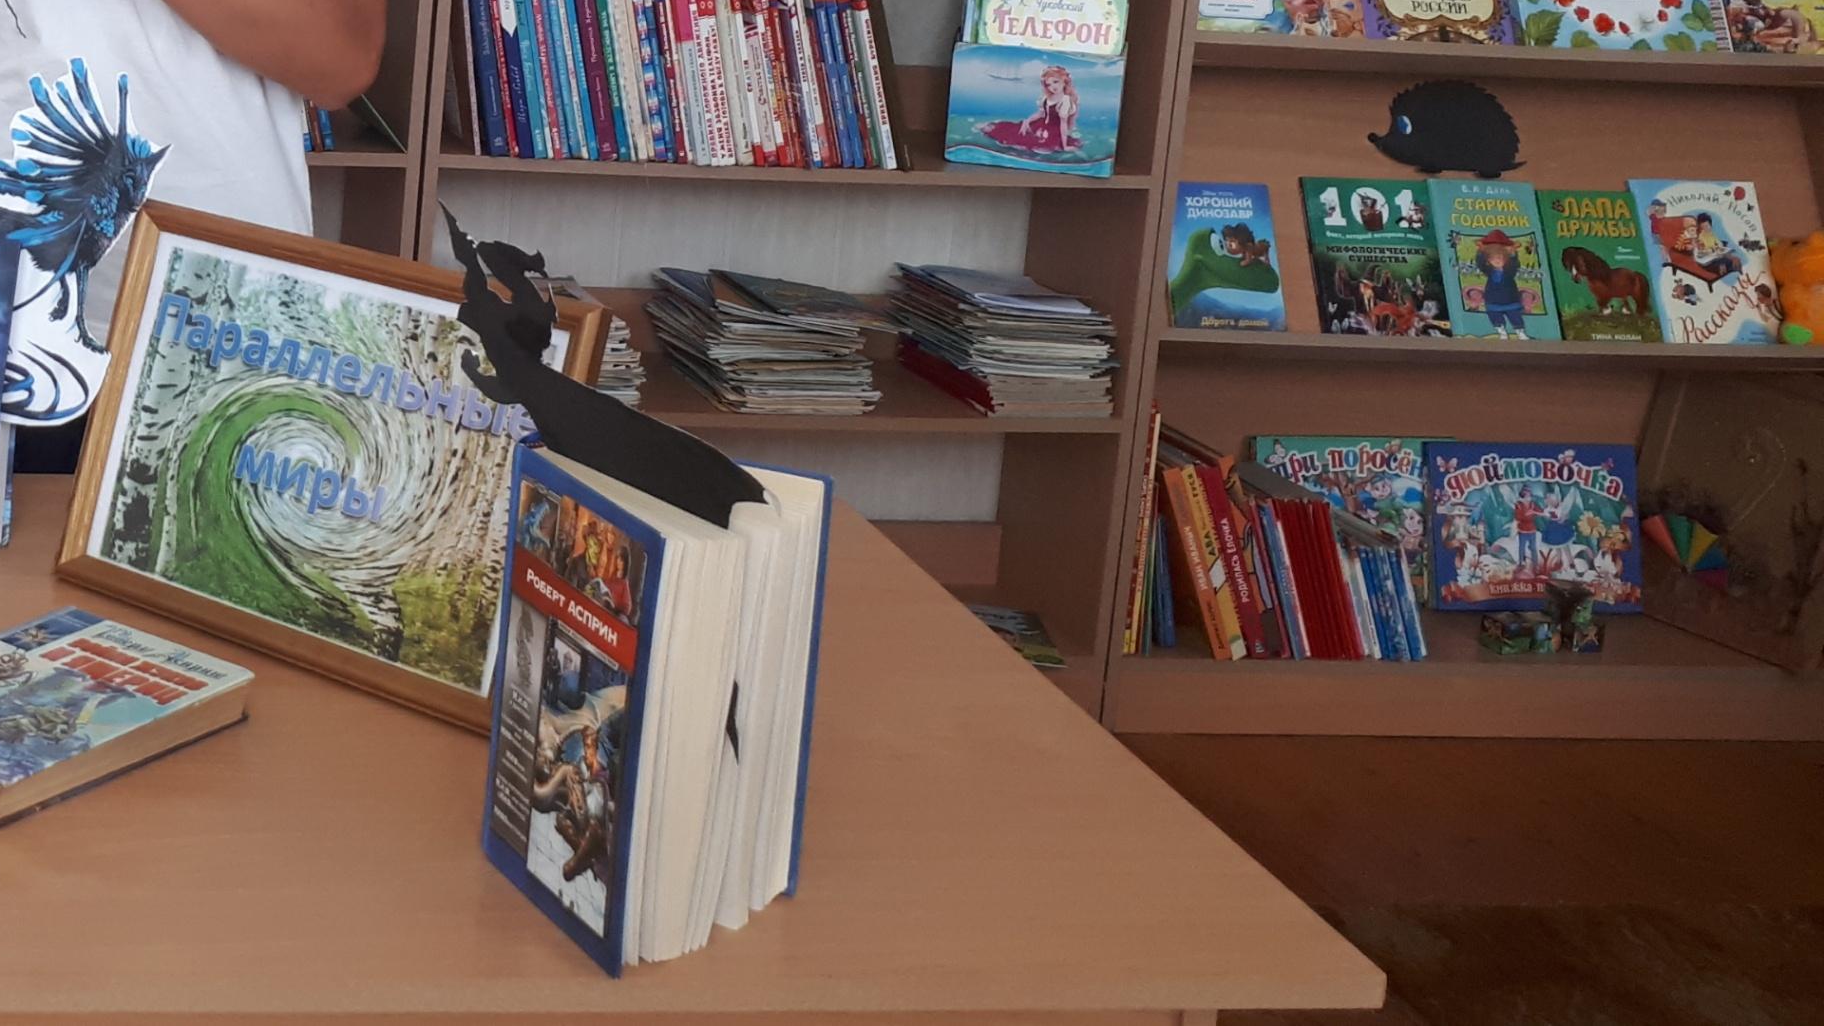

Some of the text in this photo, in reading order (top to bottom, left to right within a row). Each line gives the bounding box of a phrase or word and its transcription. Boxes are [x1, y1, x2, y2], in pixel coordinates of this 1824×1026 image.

[1411, 0, 1468, 15] РОССИИ
[992, 6, 1113, 46] ТЕЛЕФОН
[865, 18, 888, 126] ПРИКЛЮЧЕНИЯ БУРАТИНО
[1185, 195, 1253, 210] ХОРОШИЙ
[1186, 208, 1254, 220] ДИНОЗАВР
[1454, 197, 1520, 212] СТАРИК
[1561, 196, 1631, 220] ЛАПА
[1667, 194, 1722, 208] Николай
[1450, 213, 1530, 228] ГОДОВИК
[1727, 199, 1758, 232] Носов
[1556, 219, 1637, 239] ДРУЖБЫ
[1326, 244, 1427, 257] МИФОЛОГИЧЕСКИЕ
[1348, 254, 1409, 265] СУЩЕСТВА
[1680, 270, 1766, 344] Рассказы
[1591, 332, 1613, 341] ТИНА
[154, 293, 541, 440] Параллельные
[1327, 442, 1424, 478] поросён
[235, 445, 384, 521] миры
[1204, 530, 1218, 559] ДВА
[1183, 526, 1209, 591] ИВАН ИВАНЫЧ
[1221, 517, 1250, 603] РОДИЛАСЬ ЁЛОЧКА
[525, 567, 619, 648] РОБЕРТ АСПРИН
